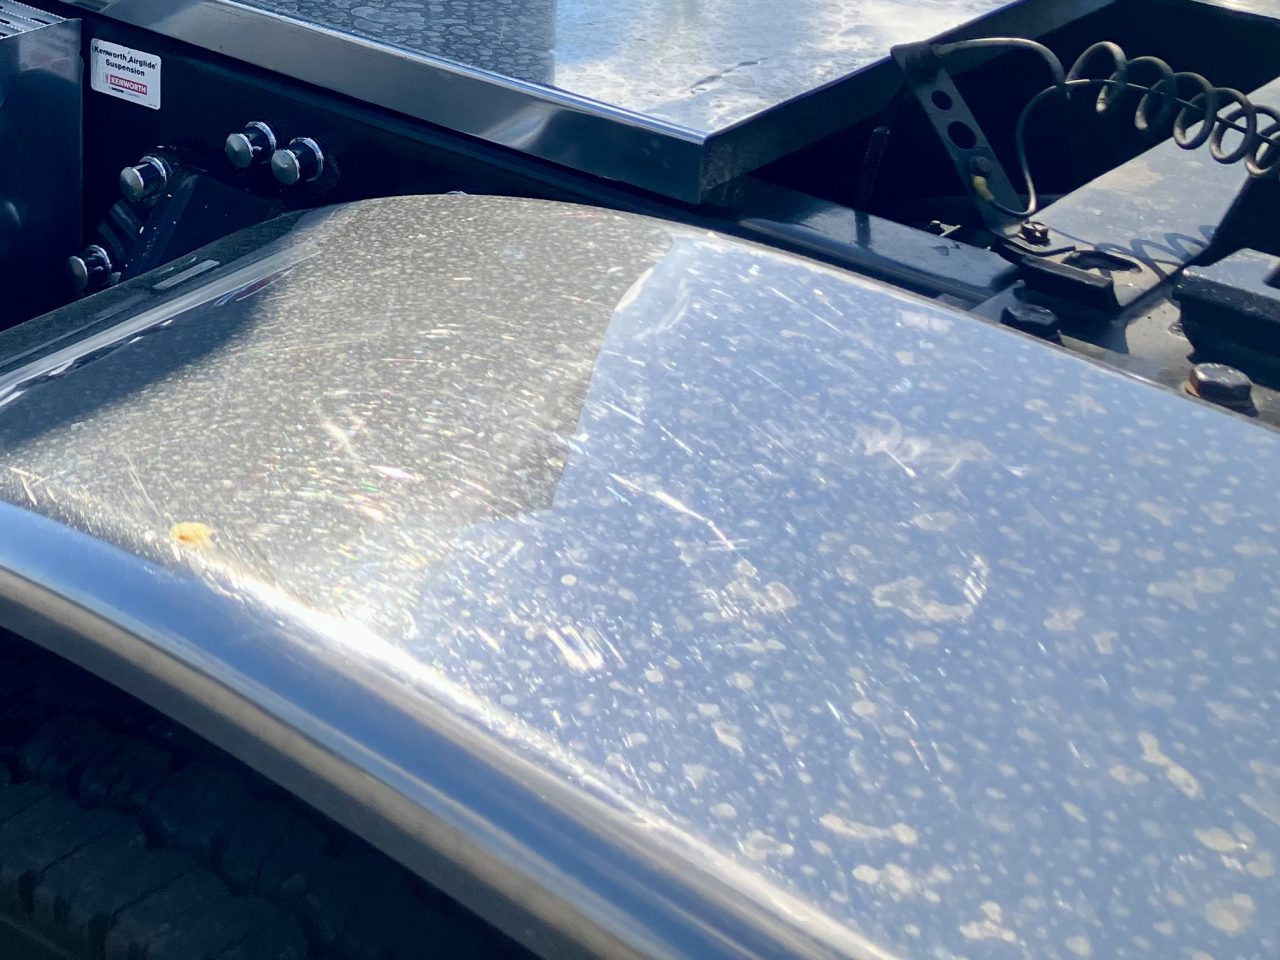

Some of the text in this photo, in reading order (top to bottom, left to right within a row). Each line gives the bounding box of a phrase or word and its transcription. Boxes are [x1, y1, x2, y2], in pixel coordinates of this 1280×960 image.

[94, 45, 156, 70] Kenworth Airglide
[105, 58, 145, 77] Suspension
[111, 76, 146, 94] KENWORTH
